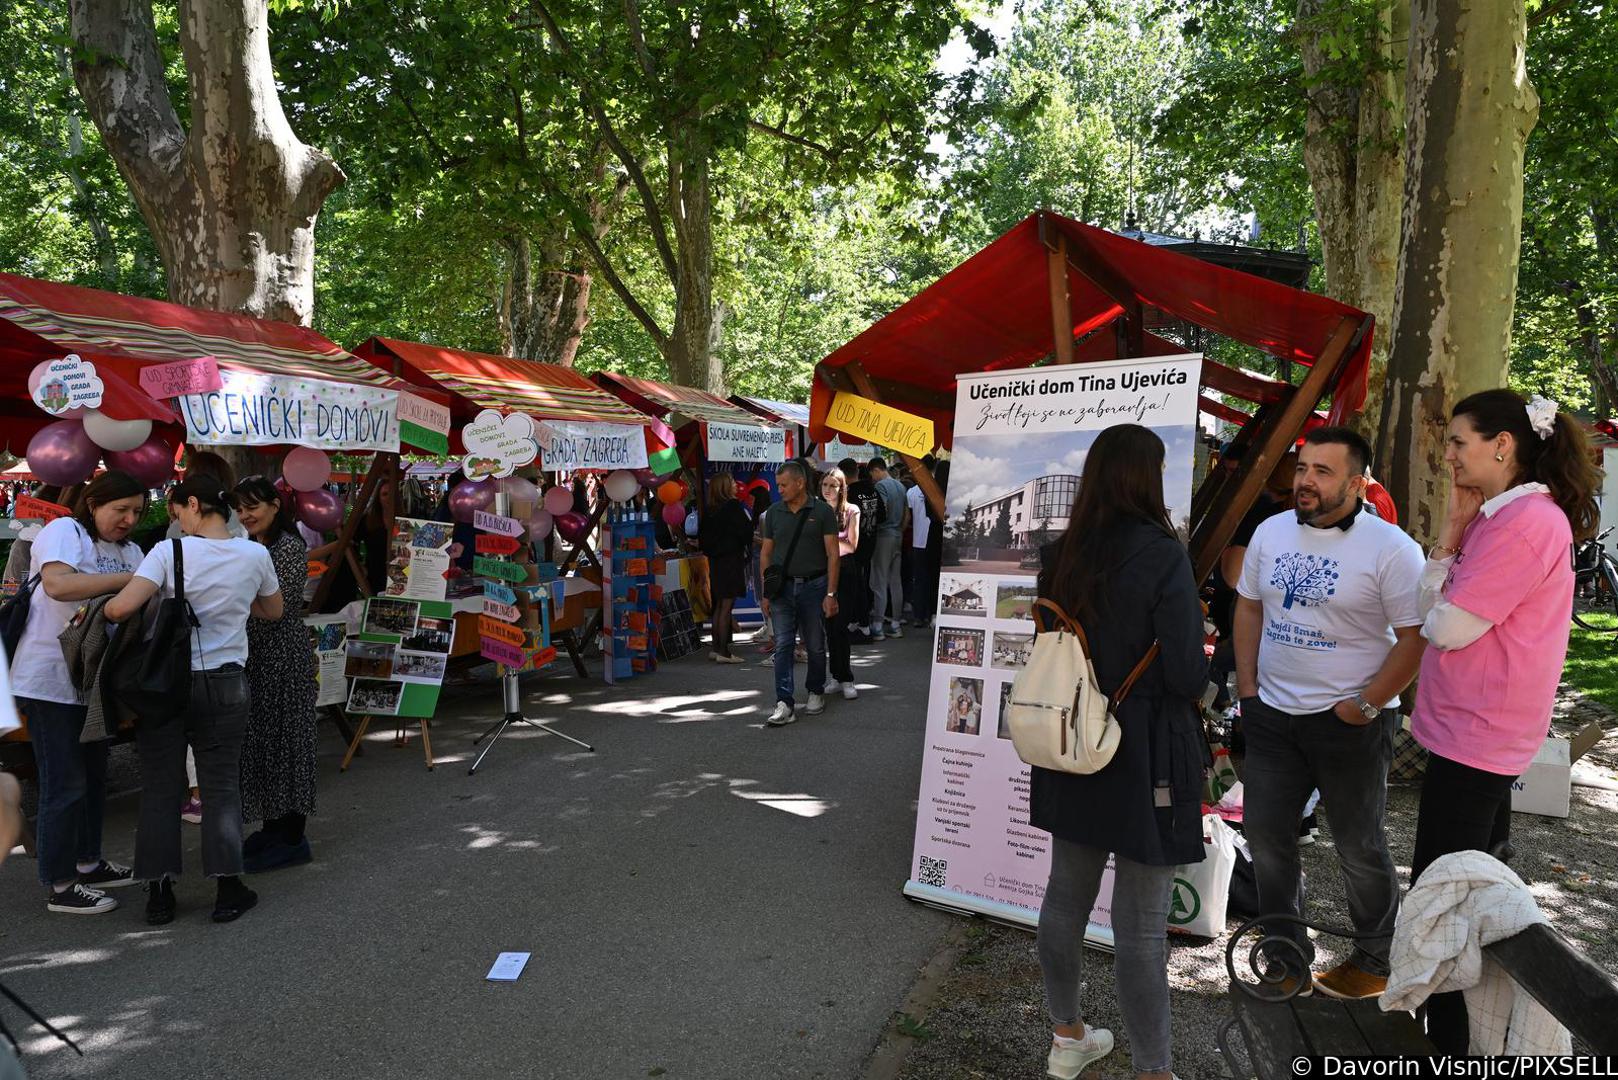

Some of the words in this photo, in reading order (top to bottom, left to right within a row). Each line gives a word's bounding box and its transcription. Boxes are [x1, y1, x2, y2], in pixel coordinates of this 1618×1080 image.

[50, 363, 78, 372] UČENIČKI
[64, 373, 86, 381] DOMOVI
[71, 382, 91, 390] GRADA
[970, 379, 1035, 400] Učenički
[1039, 379, 1075, 395] dom
[1078, 375, 1116, 392] Tina
[1121, 368, 1187, 393] Ujevića
[73, 392, 100, 401] ZAGREBA
[976, 402, 1015, 430] Život
[1040, 408, 1058, 423] se
[1059, 408, 1077, 417] ne
[1074, 392, 1171, 424] zaboravlja!
[317, 404, 389, 442] DOMOVI
[836, 402, 856, 423] UD
[857, 408, 881, 435] TINA
[884, 418, 927, 451] UJEVIĆA
[467, 424, 497, 437] UČENIČKI
[709, 424, 730, 440] ŠKOLA
[731, 430, 770, 443] SUVREMENOG
[480, 432, 506, 443] DOMOVI
[497, 440, 518, 448] GRADA
[505, 446, 532, 457] ZAGREBA
[544, 437, 578, 464] GRADA
[583, 437, 629, 464] ZAGREBA
[732, 447, 745, 458] ANE
[1294, 636, 1304, 645] te
[1307, 640, 1337, 648] zove!
[935, 817, 951, 825] Vanjski
[1007, 828, 1027, 838] Glazbeni
[1007, 841, 1046, 853] Foto-film-video
[999, 876, 1021, 886] Učenički
[1018, 888, 1034, 896] Gojka
